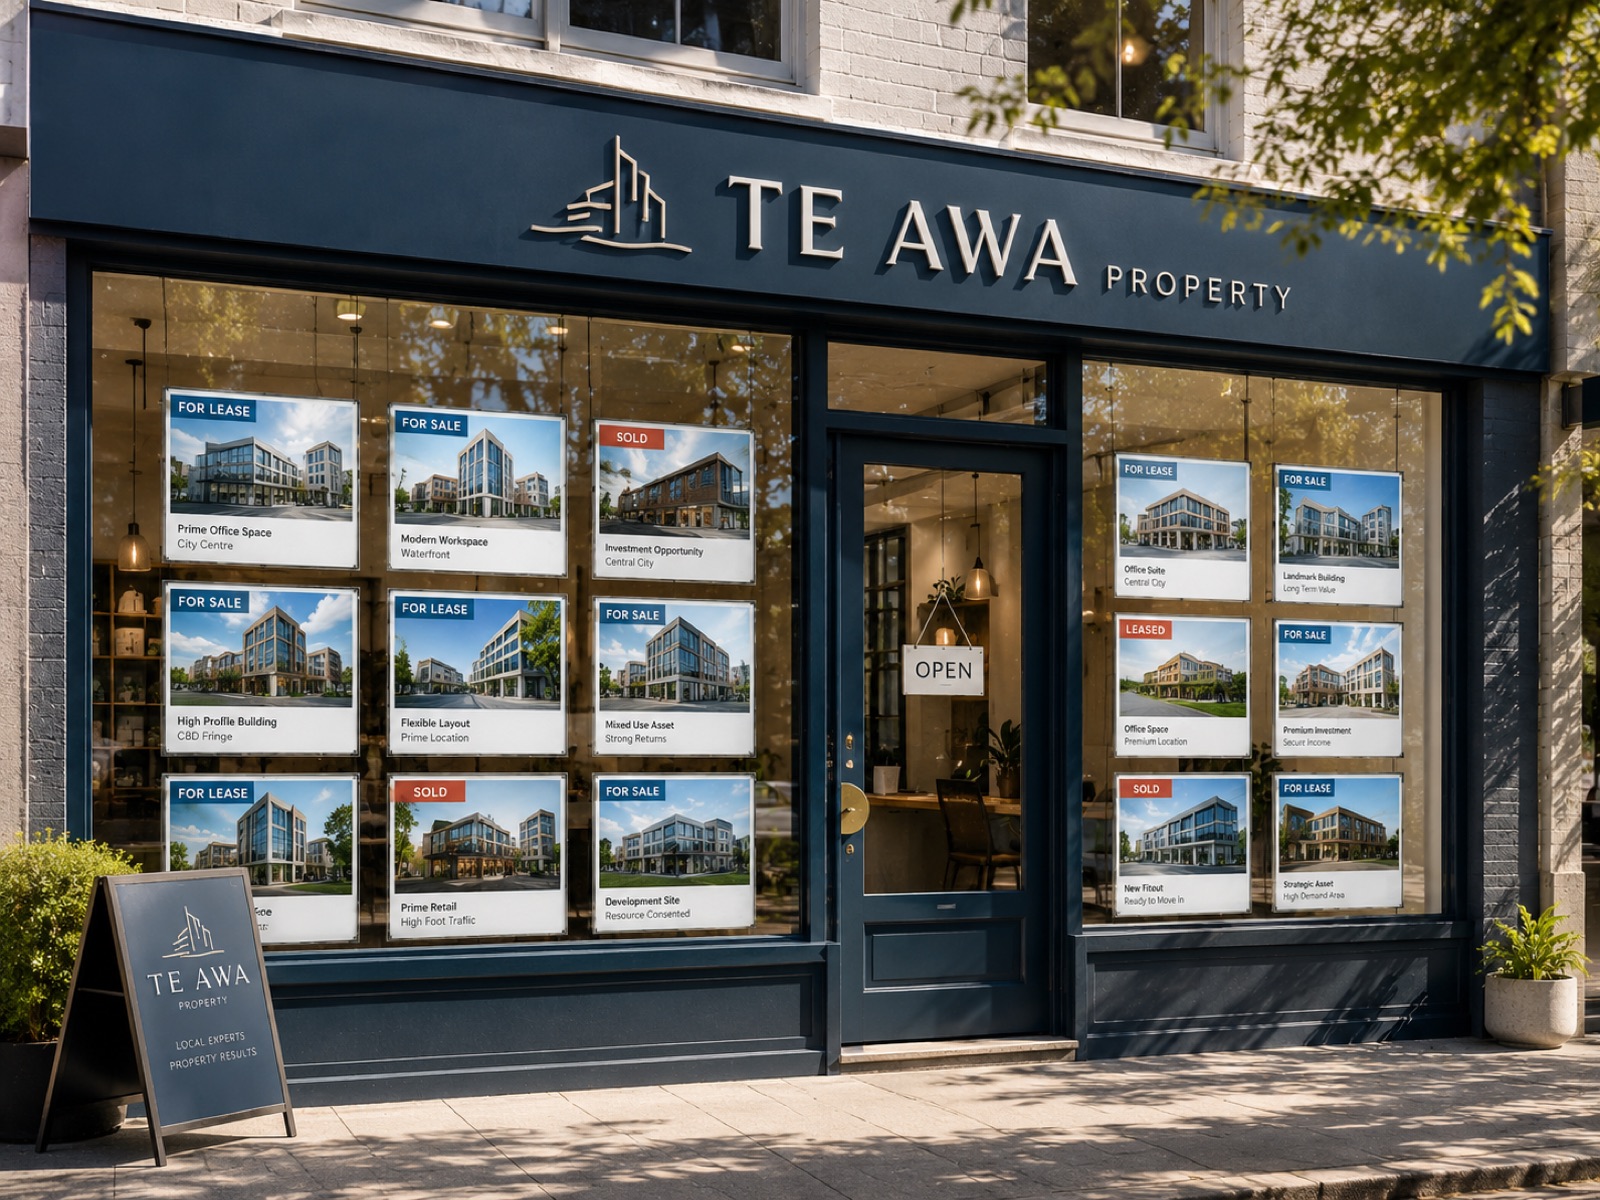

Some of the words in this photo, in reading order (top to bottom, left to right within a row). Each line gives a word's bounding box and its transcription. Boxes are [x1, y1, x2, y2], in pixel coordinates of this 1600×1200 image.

[728, 174, 845, 260] TE
[886, 199, 1078, 286] AWA
[1107, 264, 1292, 310] PROPERTY
[178, 402, 204, 414] FOR
[210, 404, 250, 417] LEASE
[402, 418, 427, 430] FOR
[431, 420, 461, 432] SALE
[617, 432, 648, 444] SOLD
[1125, 465, 1144, 474] FOR
[1146, 466, 1172, 476] LEASE
[1284, 476, 1302, 484] FOR
[1305, 476, 1326, 486] SALE
[178, 524, 207, 535] Prime
[210, 526, 240, 536] Office
[242, 527, 272, 538] Space
[178, 539, 197, 550] City
[200, 540, 233, 550] Centre
[401, 534, 436, 545] Modern
[438, 536, 488, 548] Workspace
[401, 549, 450, 560] Waterfront
[605, 544, 652, 554] Investment
[654, 546, 703, 558] Opportunity
[605, 557, 634, 567] Central
[637, 559, 654, 569] City
[1124, 566, 1146, 574] Office
[1124, 578, 1150, 586] Central
[1152, 579, 1166, 588] City
[1284, 572, 1316, 581] Landmark
[1318, 574, 1345, 583] Building
[1284, 585, 1299, 594] Long
[178, 596, 204, 608] FOR
[210, 597, 241, 609] SALE
[402, 603, 427, 614] FOR
[431, 604, 468, 614] LEASE
[606, 609, 629, 620] FOR
[632, 610, 659, 621] SALE
[1126, 625, 1165, 635] LEASED
[1284, 630, 1302, 639] FOR
[1305, 630, 1326, 640] SALE
[916, 661, 971, 678] OPEN
[178, 716, 200, 728] High
[204, 716, 235, 726] Profile
[238, 717, 277, 729] Building
[401, 718, 436, 728] Flexible
[439, 719, 470, 730] Layout
[605, 720, 631, 729] Mixed
[633, 721, 649, 730] Use
[650, 721, 674, 730] Asset
[1124, 725, 1146, 733] Office
[1148, 726, 1168, 735] Space
[177, 732, 199, 741] CBD
[202, 732, 232, 742] Fringe
[401, 732, 428, 742] Prime
[431, 733, 469, 743] Location
[605, 734, 632, 744] Strong
[635, 734, 666, 743] Returns
[1124, 738, 1156, 746] Premium
[1158, 738, 1187, 746] Location
[178, 788, 204, 799] FOR
[209, 788, 248, 798] LEASE
[413, 787, 447, 798] SOLD
[606, 786, 629, 797] FOR
[632, 786, 659, 796] SALE
[1134, 784, 1160, 794] SOLD
[1284, 784, 1302, 793] FOR
[1305, 784, 1330, 792] LEASE
[1124, 884, 1140, 892] New
[1284, 880, 1313, 889] Strategic
[1316, 880, 1333, 888] Asset
[1124, 896, 1146, 906] Ready
[1158, 896, 1176, 904] Move
[1284, 892, 1299, 900] High
[1301, 892, 1327, 900] Demand
[401, 903, 428, 912] Prime
[431, 902, 456, 912] Retail
[605, 897, 661, 908] Development
[663, 896, 680, 905] Site
[605, 910, 644, 920] Resource
[647, 909, 690, 919] Consented
[401, 917, 422, 928] High
[425, 916, 445, 926] Foot
[448, 915, 476, 925] Traffic
[147, 970, 183, 996] TE
[196, 964, 250, 990] AWA
[179, 996, 227, 1010] PROPERTY
[176, 1038, 205, 1050] LOCAL
[209, 1032, 245, 1044] EXPERTS
[170, 1055, 217, 1070] PROPERTY
[220, 1047, 257, 1061] RESULTS
